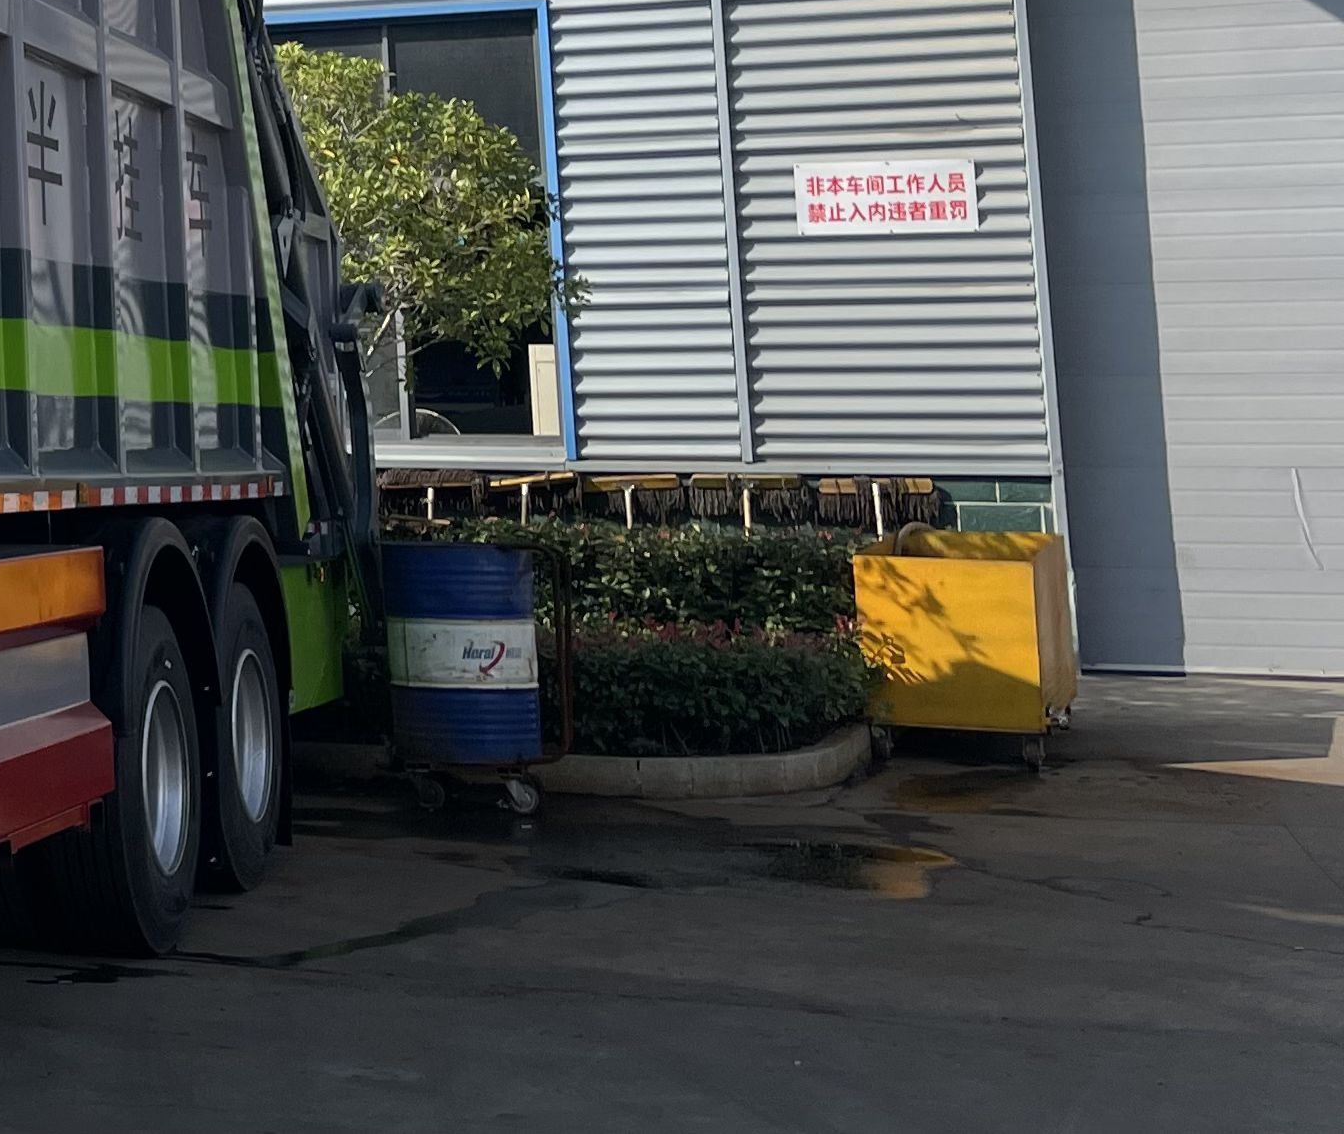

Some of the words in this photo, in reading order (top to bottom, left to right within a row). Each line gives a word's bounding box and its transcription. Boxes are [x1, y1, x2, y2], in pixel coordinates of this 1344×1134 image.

[806, 173, 966, 197] 非本车间工作人员
[808, 200, 968, 223] 禁止入内违者重罚
